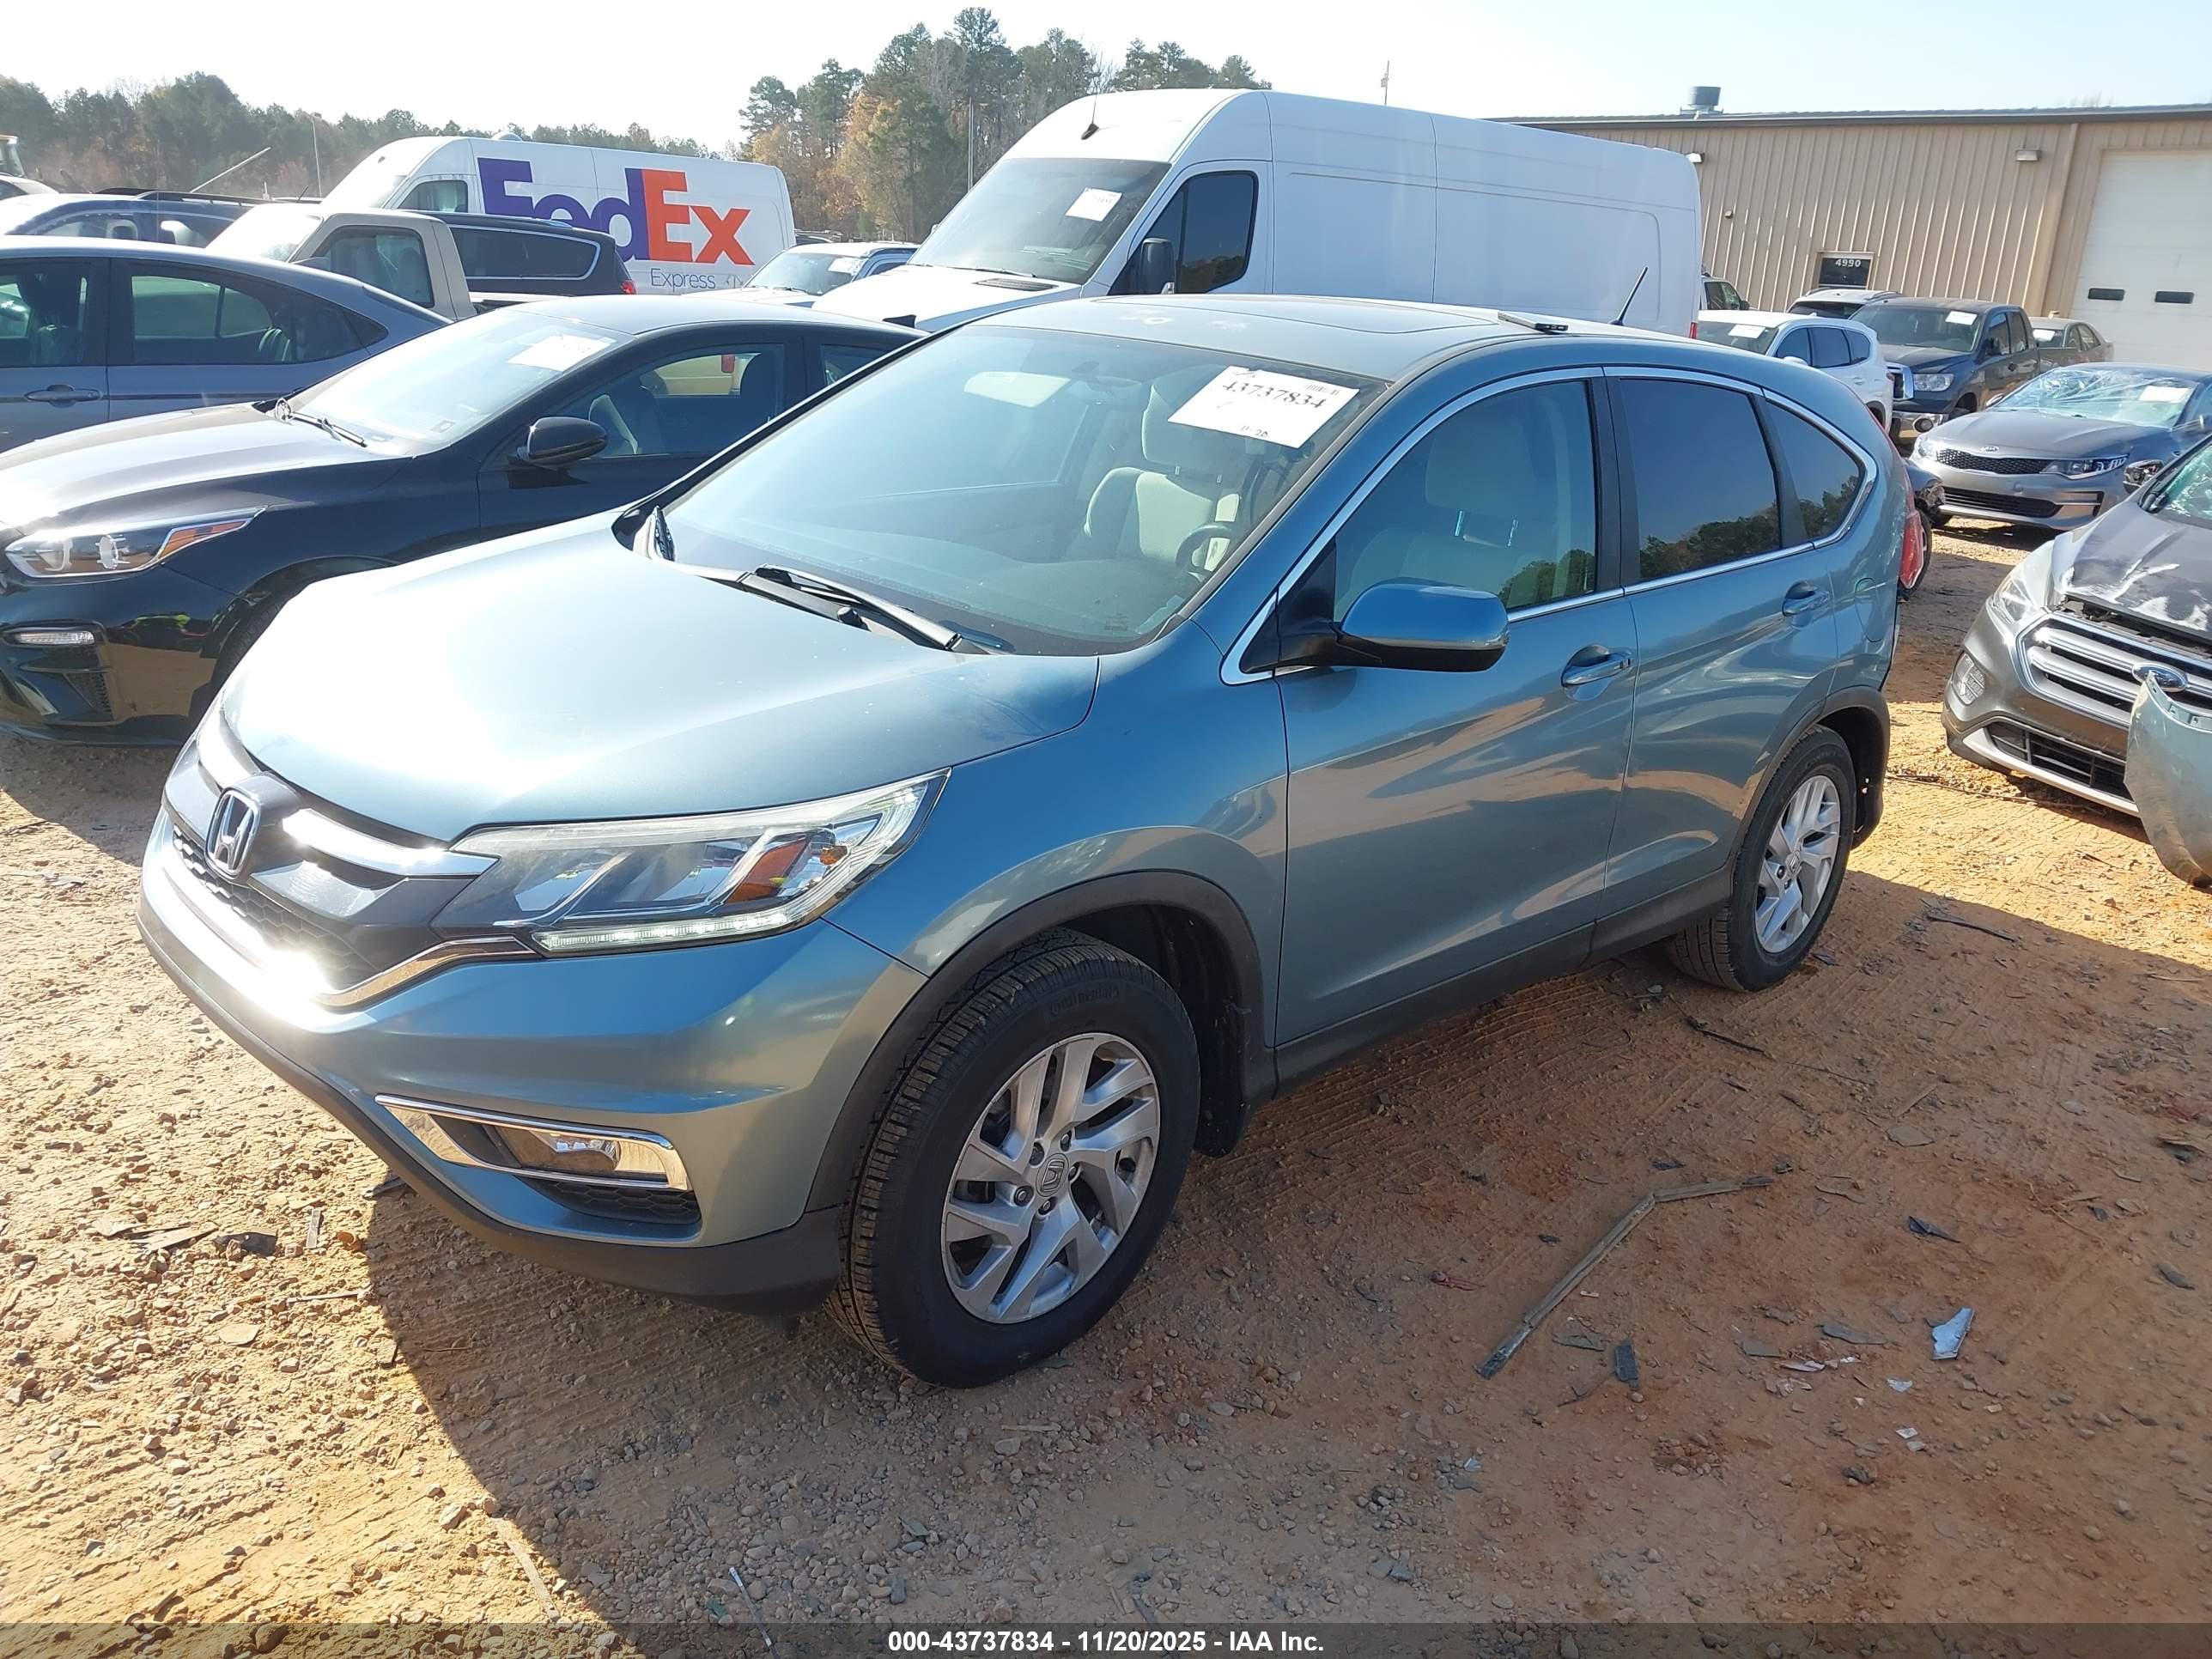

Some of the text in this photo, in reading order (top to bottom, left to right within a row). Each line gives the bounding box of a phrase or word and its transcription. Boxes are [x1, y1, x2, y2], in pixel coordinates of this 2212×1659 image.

[1835, 258, 1862, 268] 4990
[650, 268, 716, 293] Express
[1223, 380, 1327, 408] 43737834
